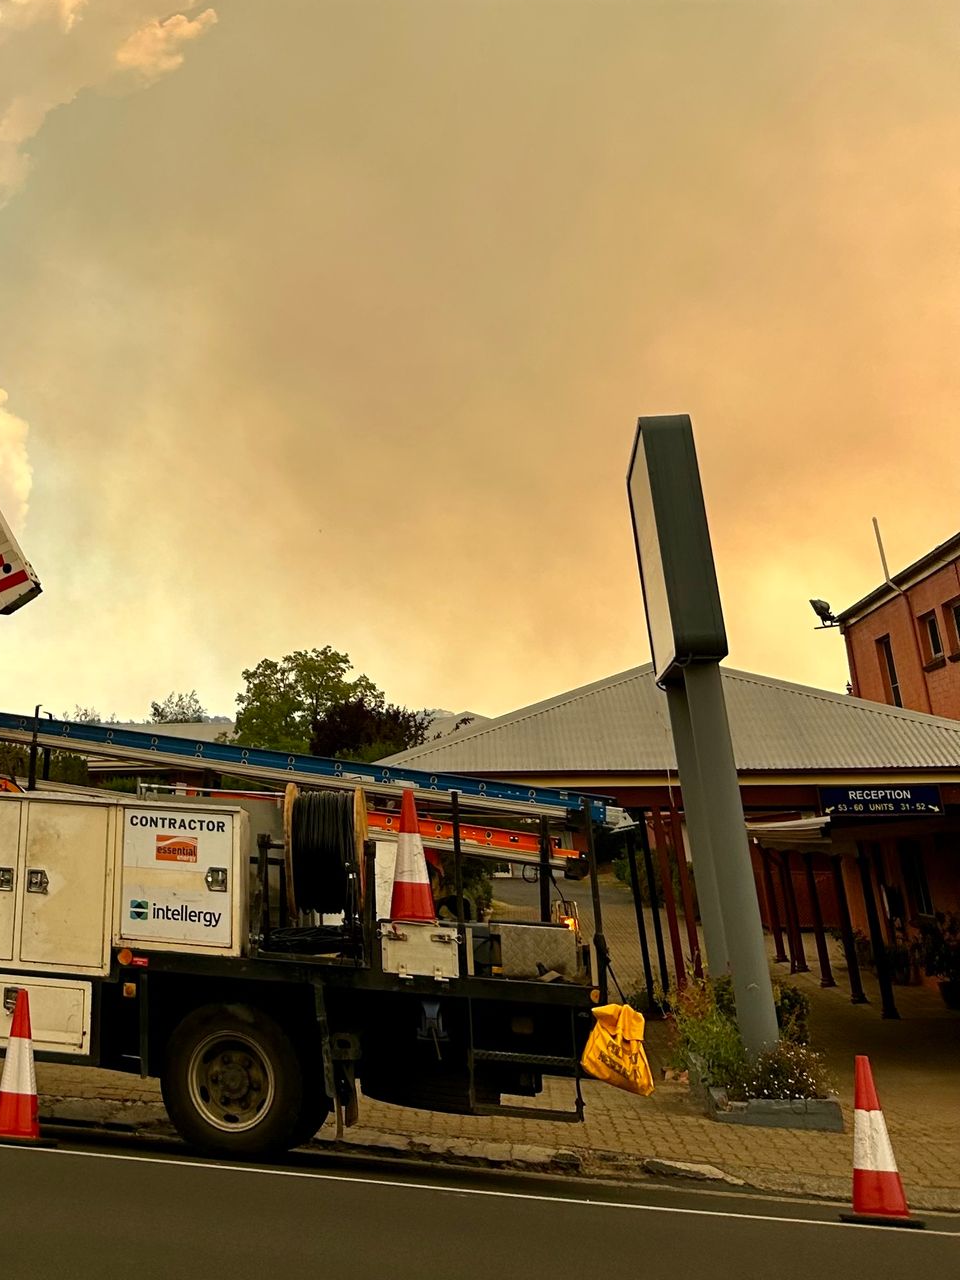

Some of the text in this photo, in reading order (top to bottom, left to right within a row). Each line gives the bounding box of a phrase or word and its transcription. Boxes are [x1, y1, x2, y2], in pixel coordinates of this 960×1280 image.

[848, 790, 911, 800] RECEPTION
[868, 803, 894, 811] UNITS
[130, 815, 225, 833] CONTRACTOR
[157, 845, 197, 857] essential
[152, 903, 221, 927] intellergy
